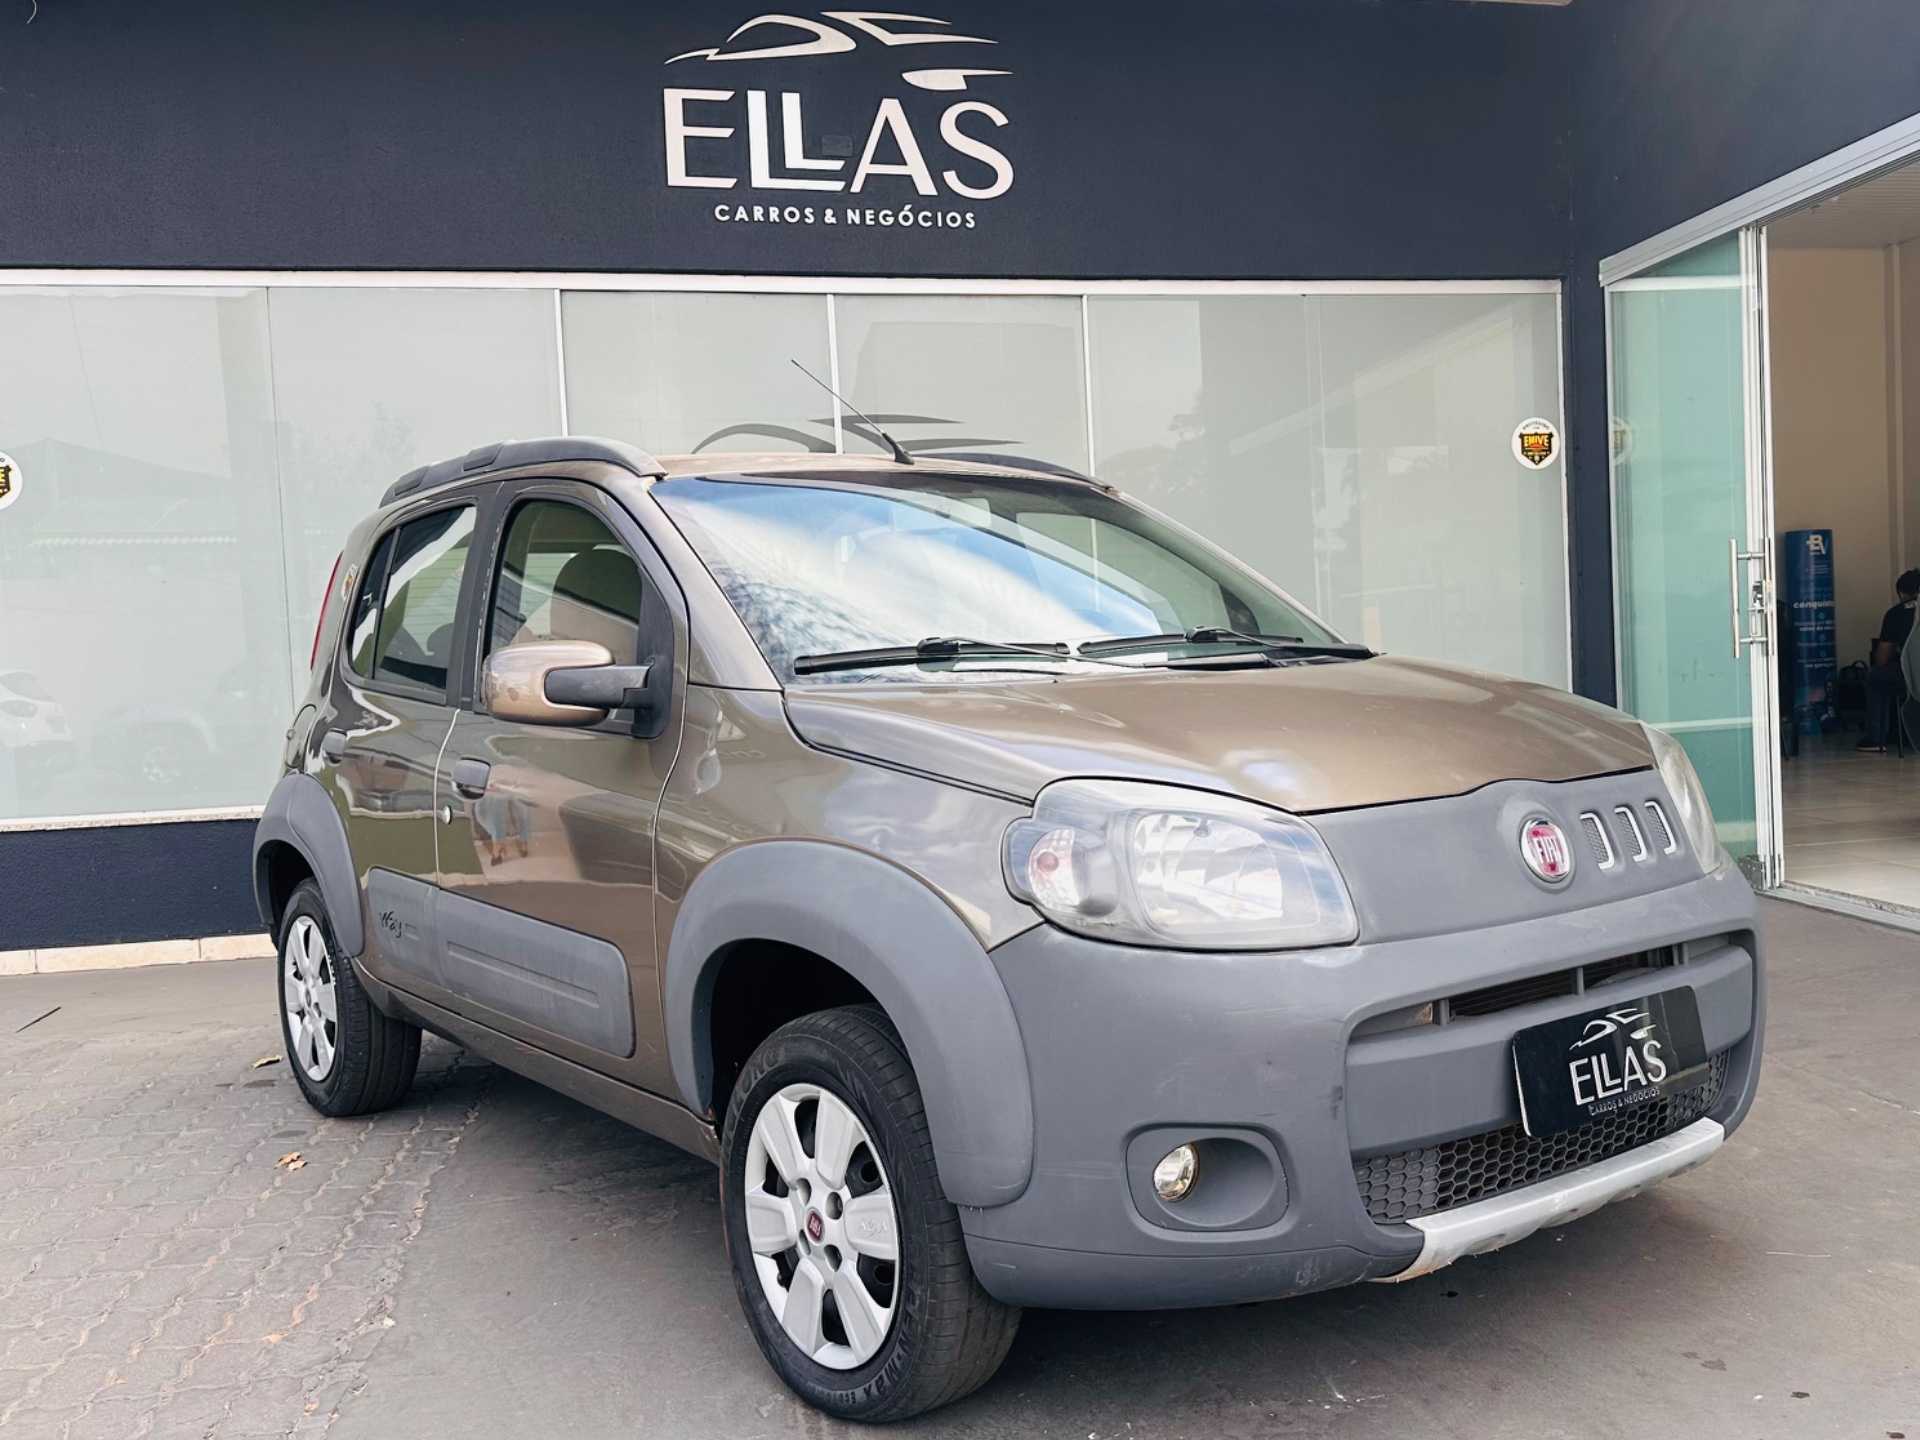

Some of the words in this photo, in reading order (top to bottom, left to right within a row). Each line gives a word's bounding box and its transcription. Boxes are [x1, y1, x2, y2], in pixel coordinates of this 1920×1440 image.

[664, 88, 1014, 199] ELLAS
[715, 204, 814, 224] CARROS
[823, 207, 837, 224] &
[847, 204, 976, 228] NEGÓCIOS
[1533, 835, 1563, 864] FIAT
[1569, 1040, 1667, 1106] ELLAS
